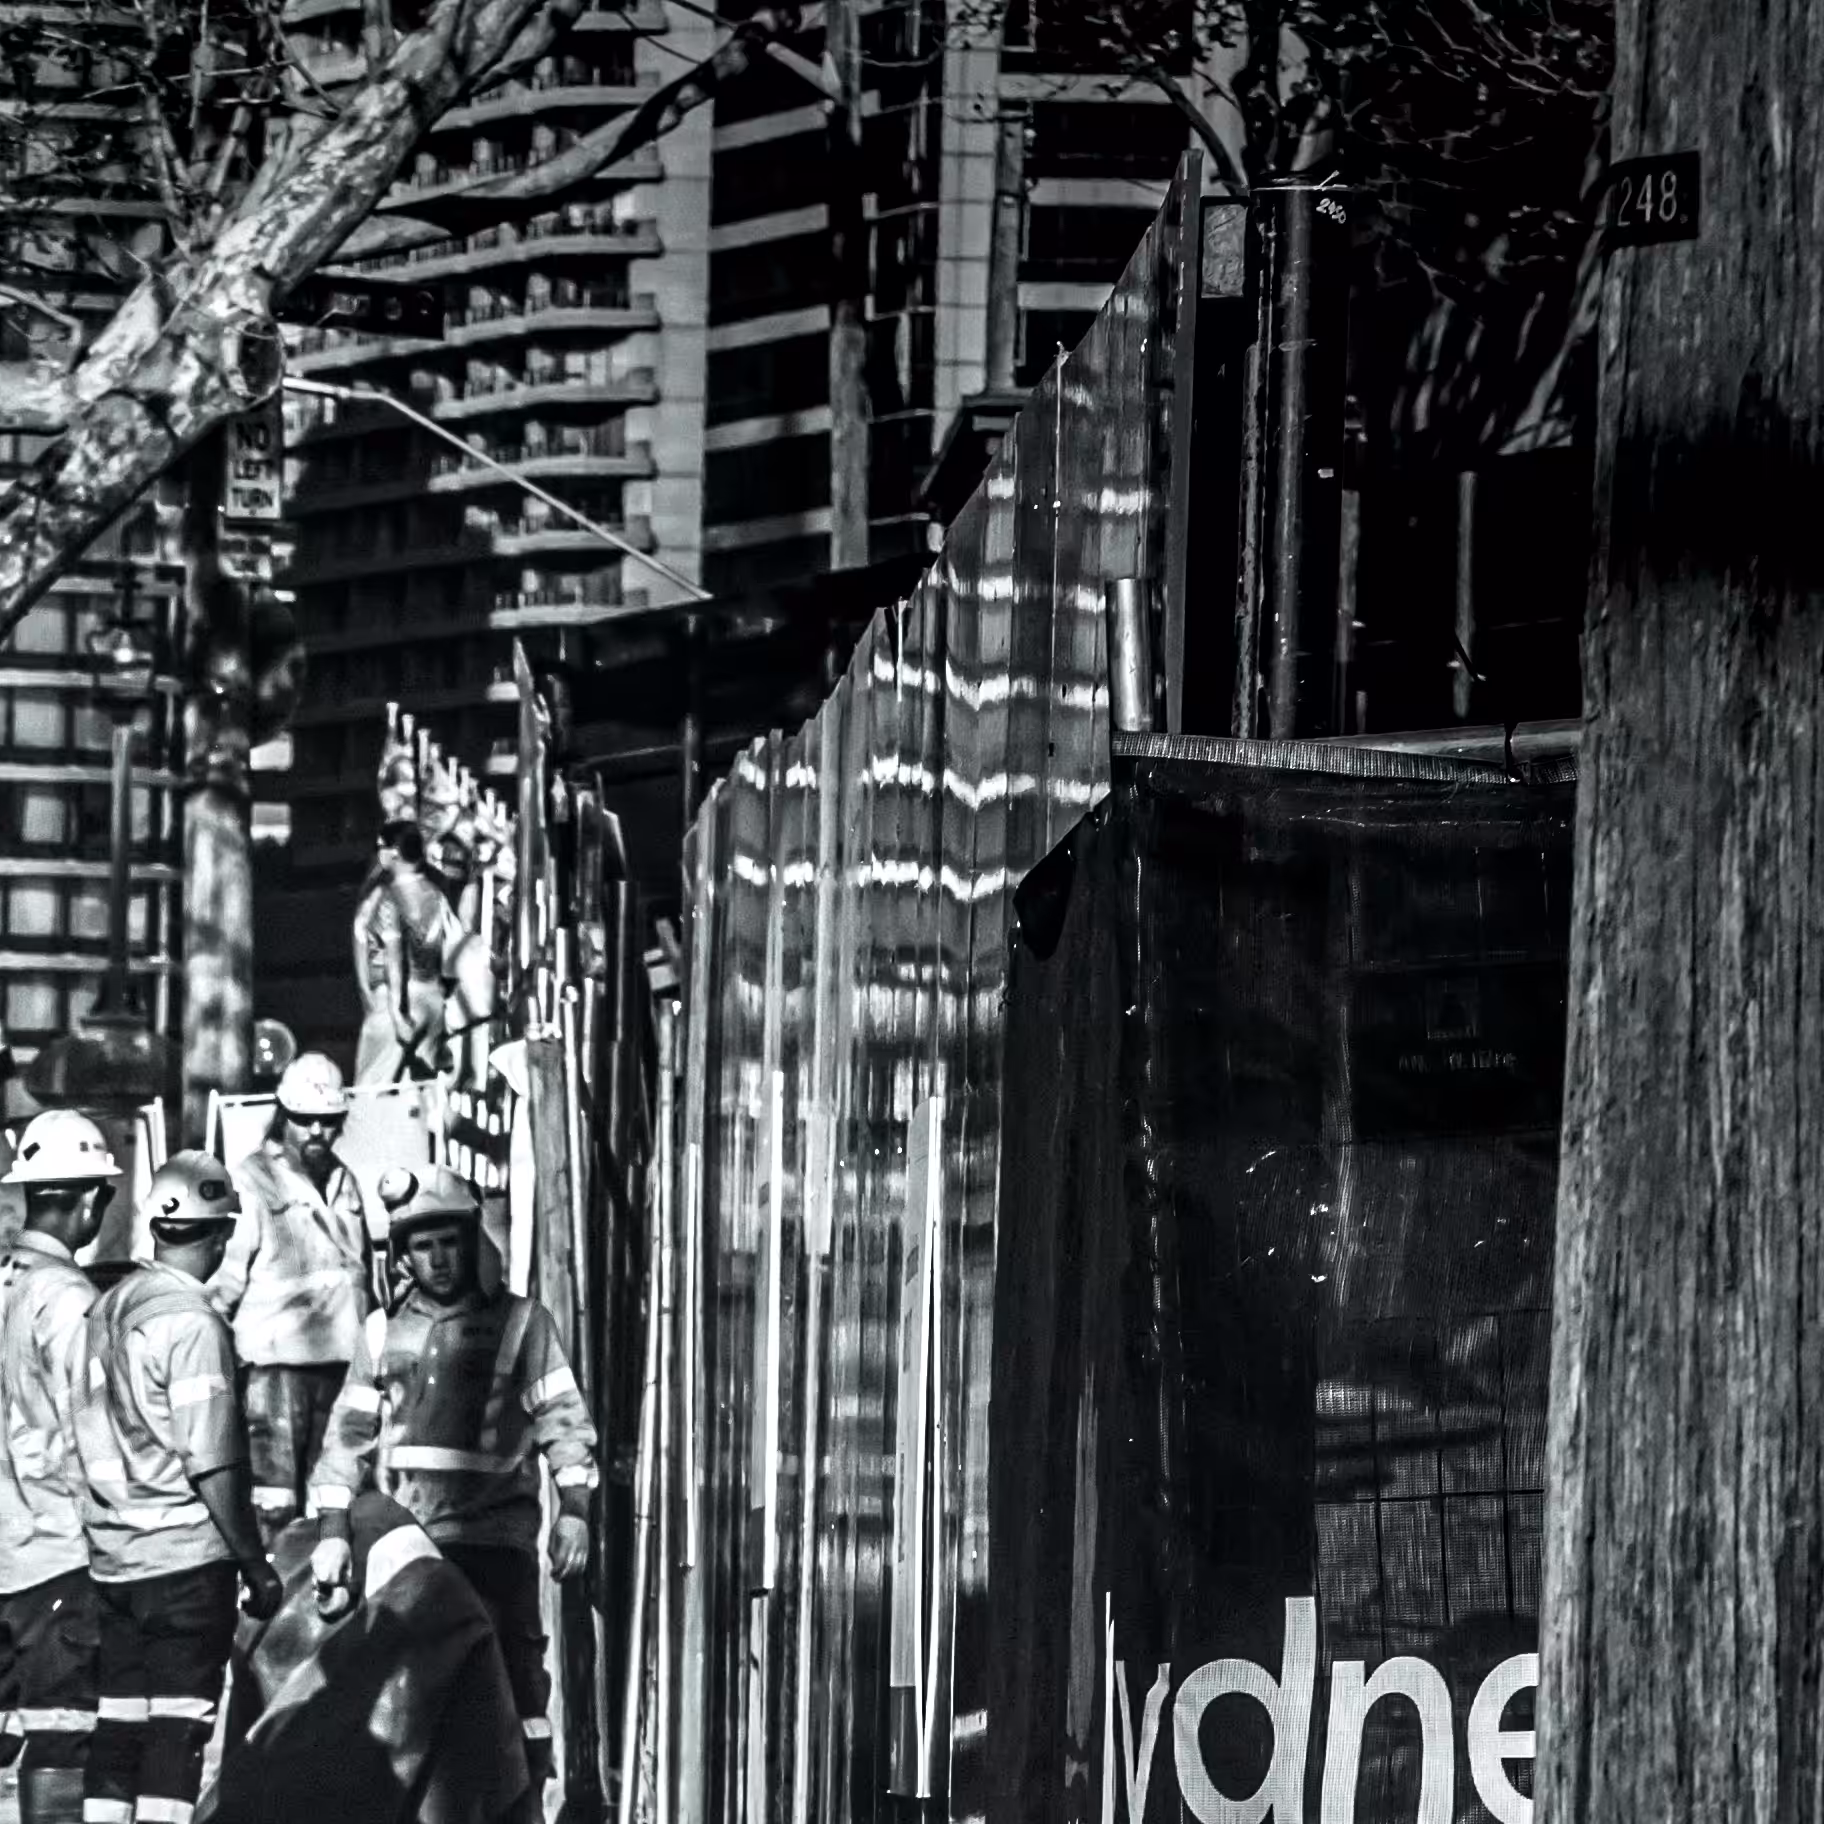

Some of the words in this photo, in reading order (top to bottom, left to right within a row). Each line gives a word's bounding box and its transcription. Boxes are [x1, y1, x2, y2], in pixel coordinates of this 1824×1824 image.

[1617, 170, 1678, 227] 248
[235, 421, 271, 451] NO
[234, 458, 276, 480] LEFT
